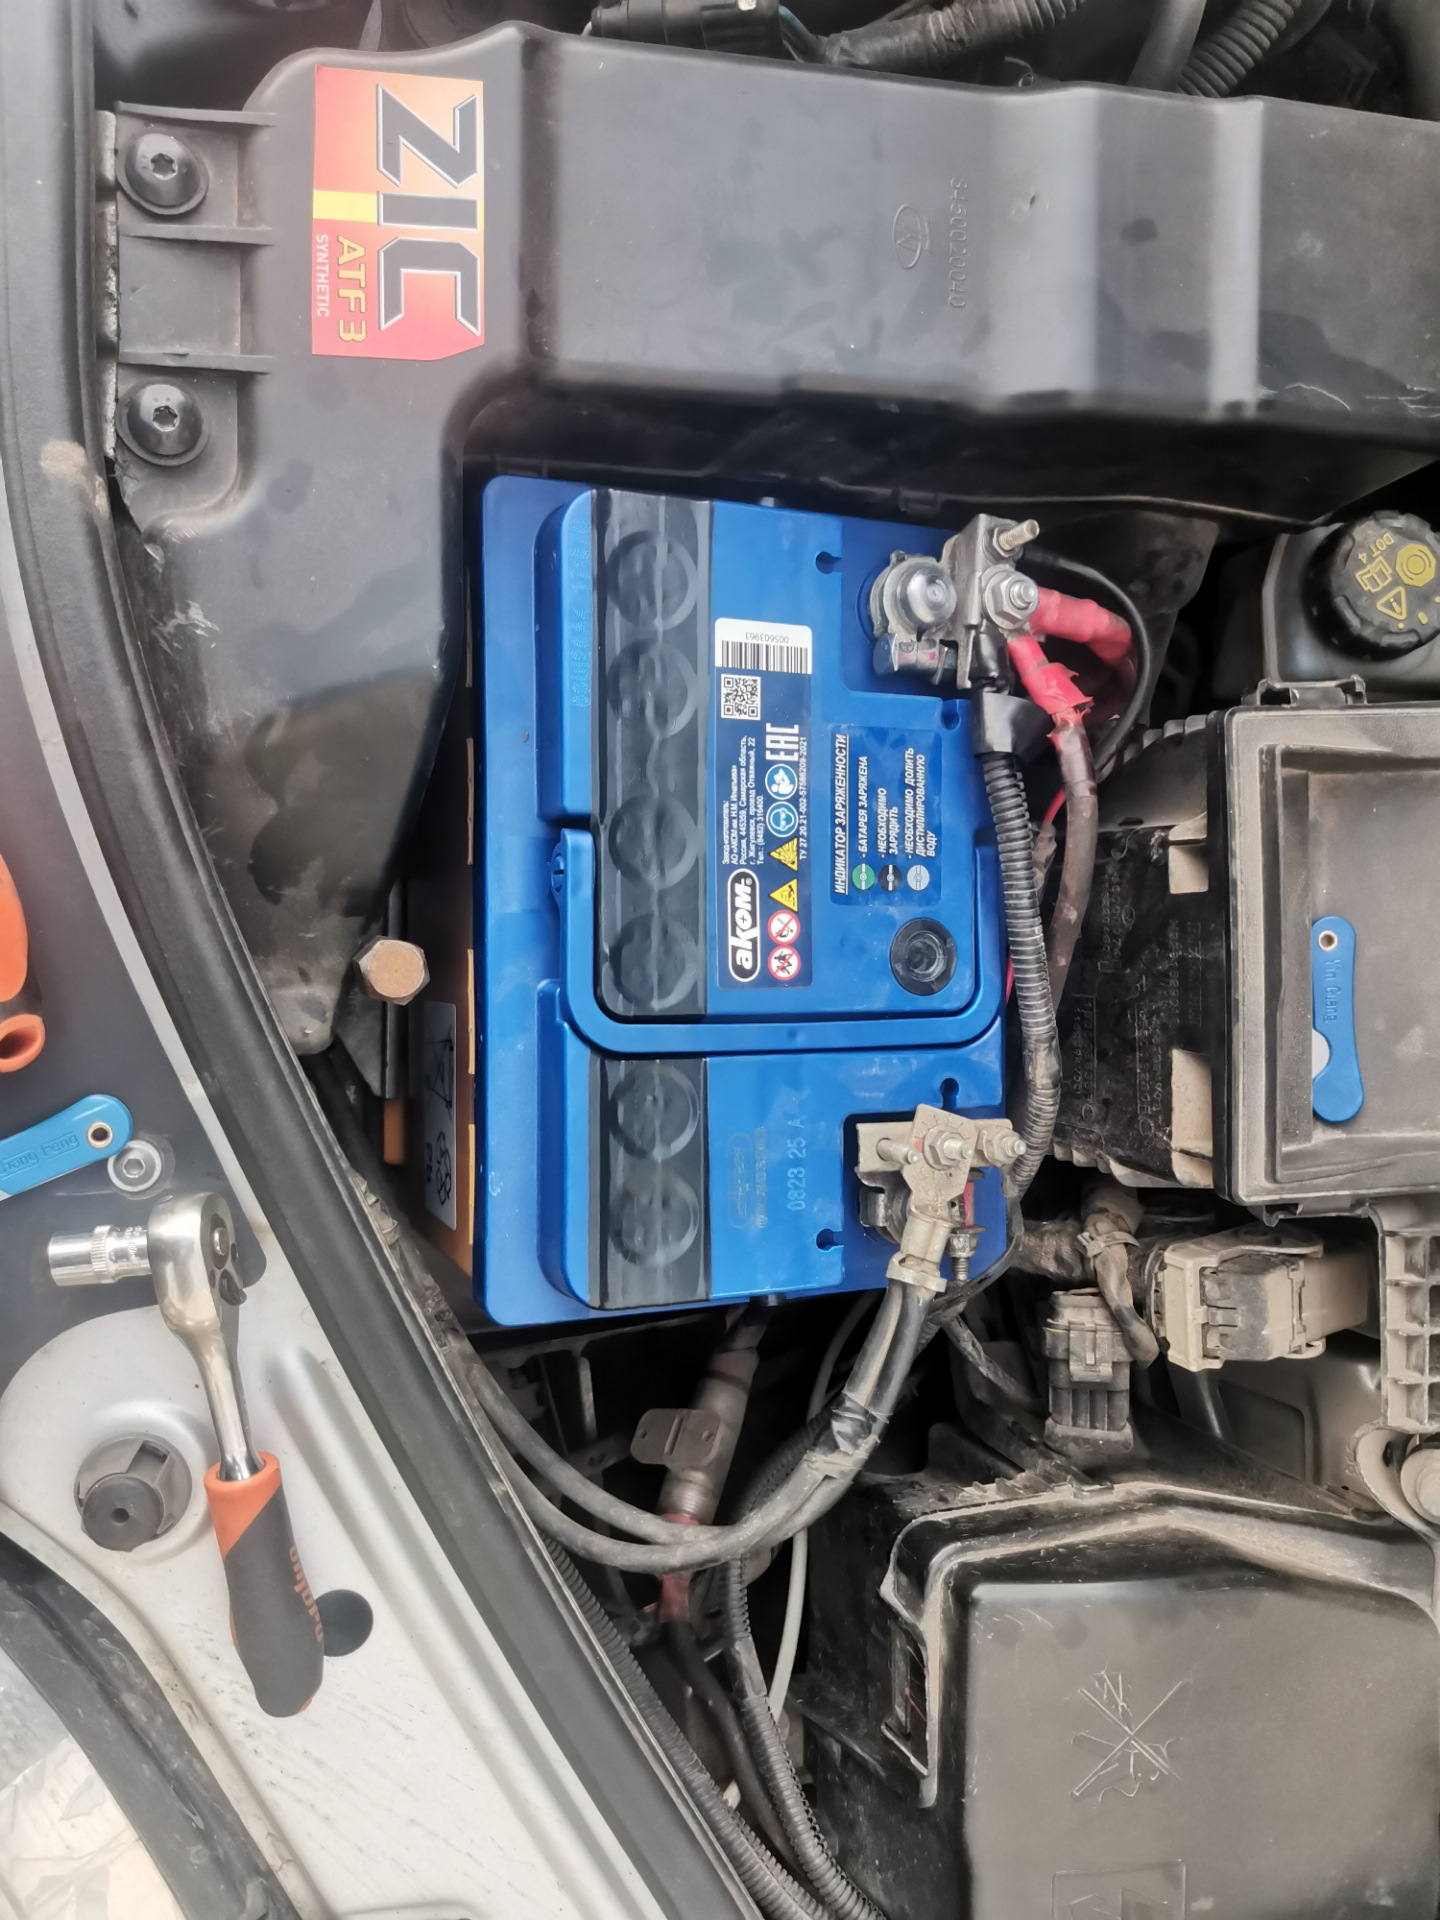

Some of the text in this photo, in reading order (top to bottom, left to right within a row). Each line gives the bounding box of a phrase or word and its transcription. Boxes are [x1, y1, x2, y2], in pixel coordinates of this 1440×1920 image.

[377, 83, 481, 337] ZIC
[316, 233, 330, 318] SYNTHETIC
[337, 235, 367, 343] ATF 3
[1357, 532, 1395, 565] DOT 4
[748, 737, 756, 747] 22
[858, 756, 868, 808] ЗАРЯЖЕНА
[904, 747, 914, 786] ДОЛИТЬ
[740, 768, 748, 807] Самарская
[916, 754, 926, 857] ДИСТИЛЛИРОВАННУЮ
[834, 733, 847, 894] ИНДИКАТОР ЗАРЯЖЕННОСТИ
[889, 806, 899, 855] ЗАРЯДИТЬ
[740, 838, 748, 865] Россия,
[756, 822, 765, 846] (8482)
[926, 830, 936, 857] ВОДУ
[731, 854, 738, 865] АО
[799, 848, 807, 860] ТУ
[0, 1149, 39, 1179] hang
[787, 1137, 806, 1158] 25
